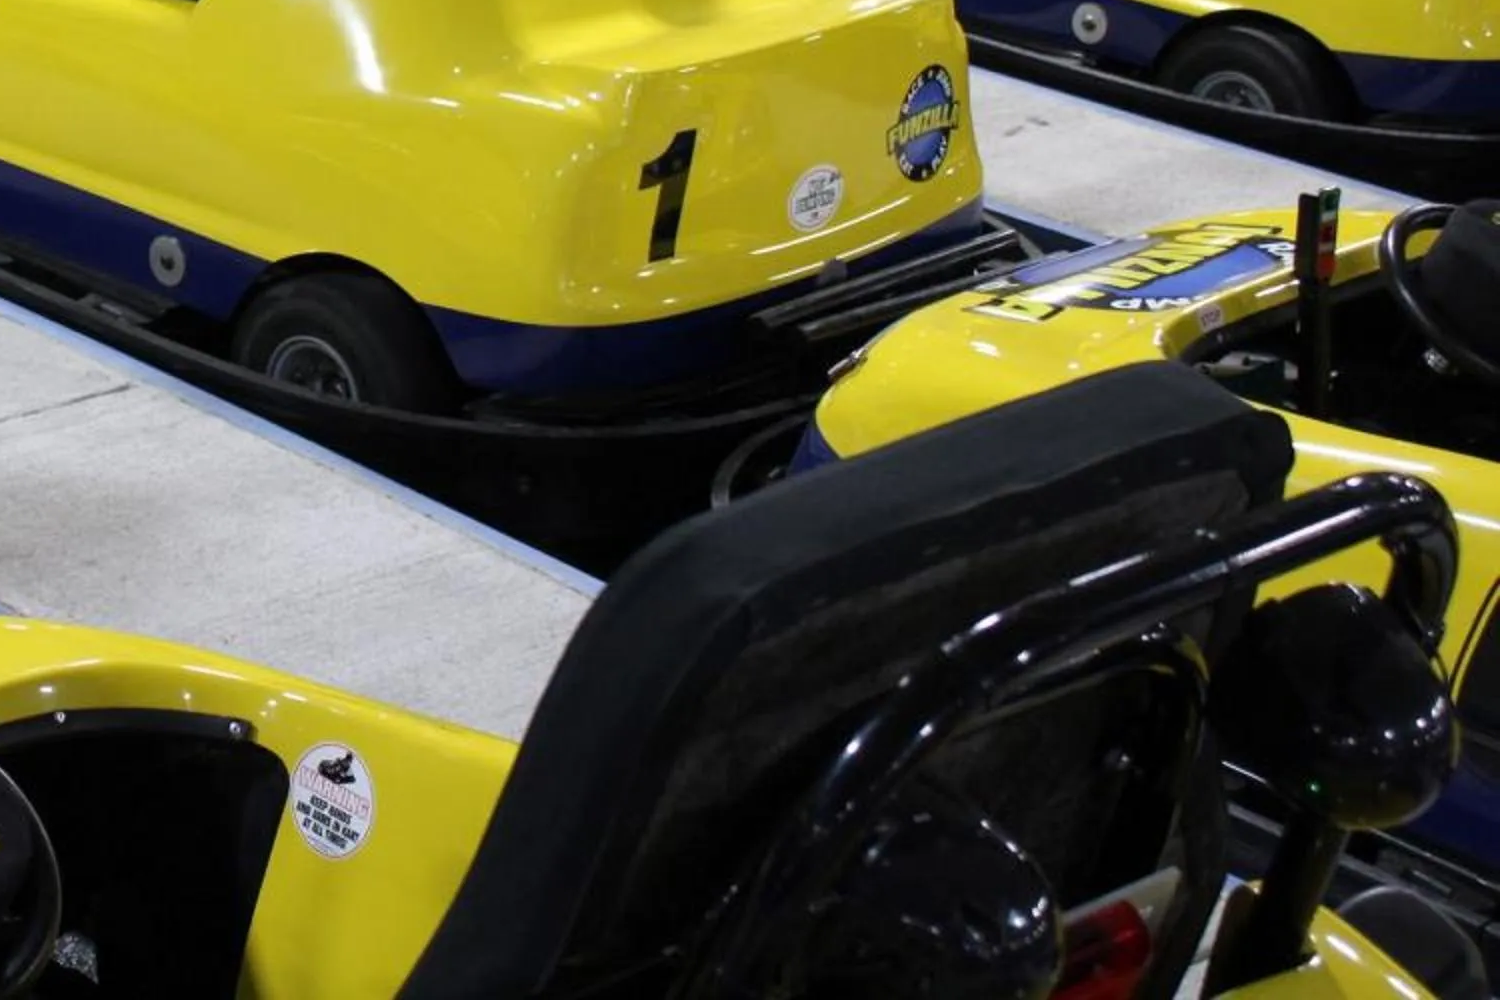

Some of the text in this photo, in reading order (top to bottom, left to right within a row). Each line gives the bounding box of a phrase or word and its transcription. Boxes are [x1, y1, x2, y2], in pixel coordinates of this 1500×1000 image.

[888, 102, 959, 154] FUNZILLA
[639, 129, 697, 263] 1
[299, 763, 370, 818] WARNING
[310, 794, 329, 811] KEEP
